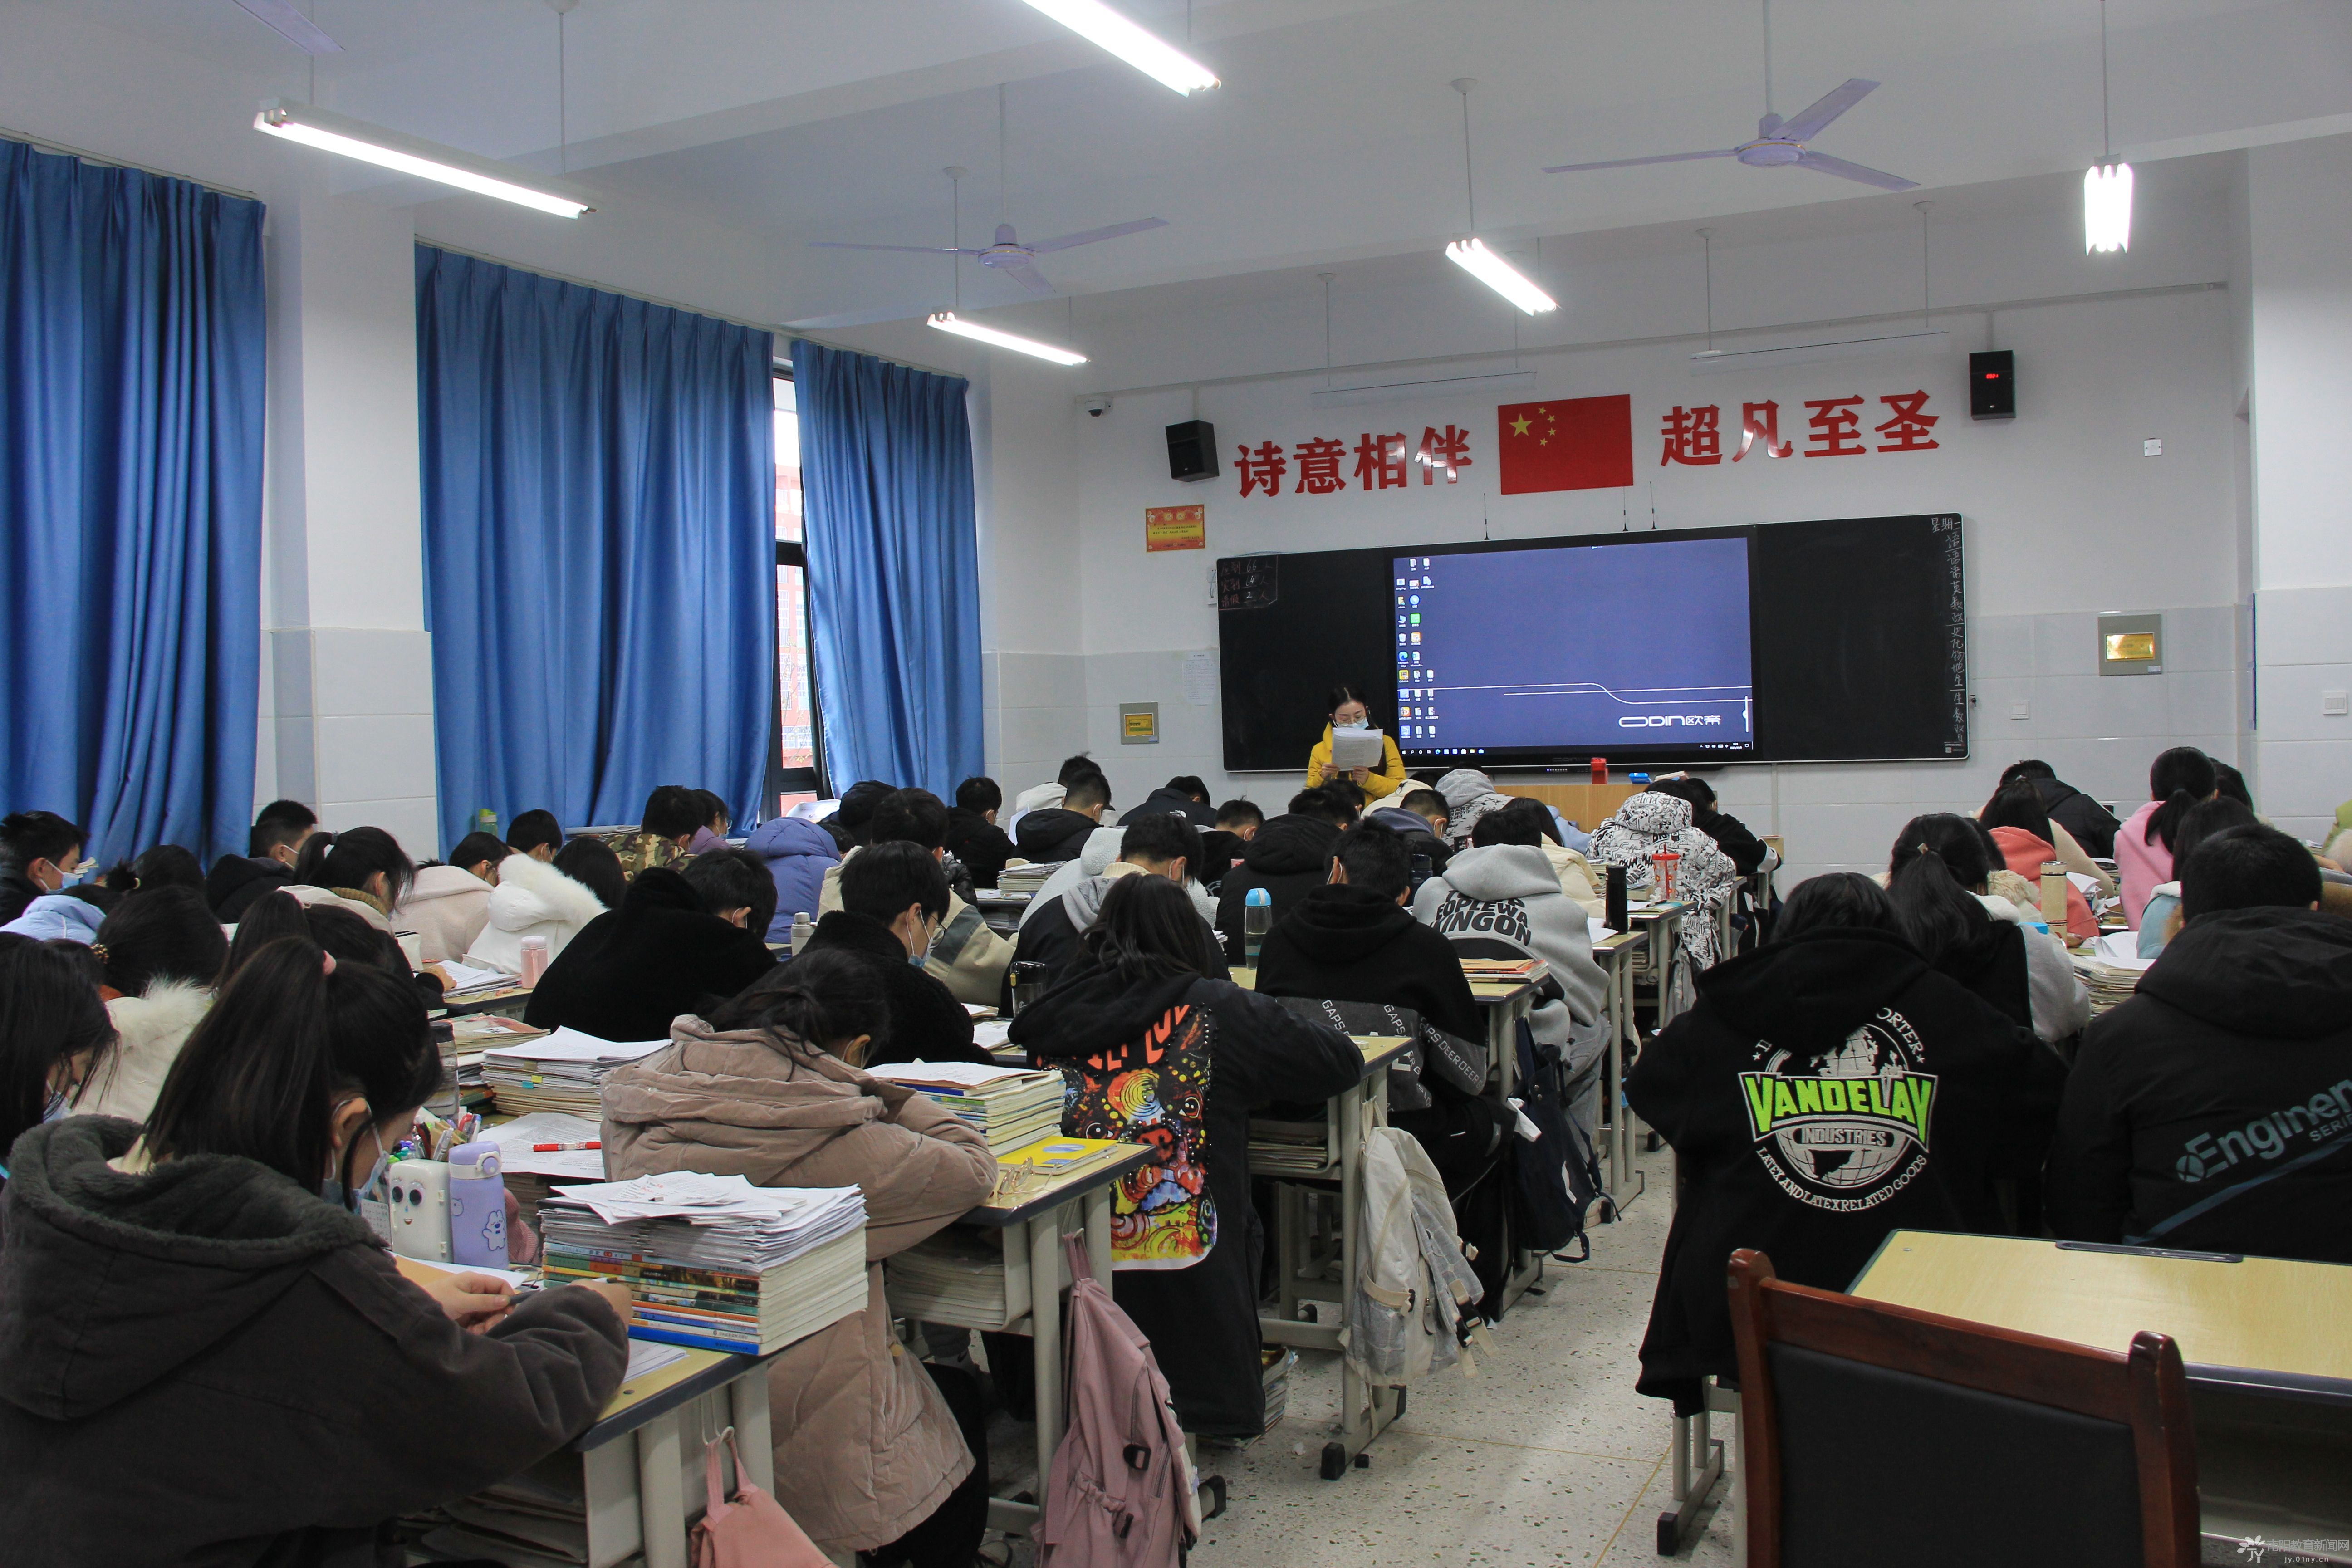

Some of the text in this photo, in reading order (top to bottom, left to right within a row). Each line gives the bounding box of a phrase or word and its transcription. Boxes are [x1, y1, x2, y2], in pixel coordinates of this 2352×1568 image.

[1661, 390, 1940, 466] 超凡至圣
[1234, 425, 1473, 498] 诗意相伴
[1322, 1000, 1346, 1030] GAPS
[1384, 1004, 1406, 1035] GAPS
[1744, 1077, 1931, 1144] VANDELAY
[1801, 1127, 1887, 1147] INDUSTRIES
[1756, 1147, 1927, 1212] LATEX AND LATEX RELATED GOODS
